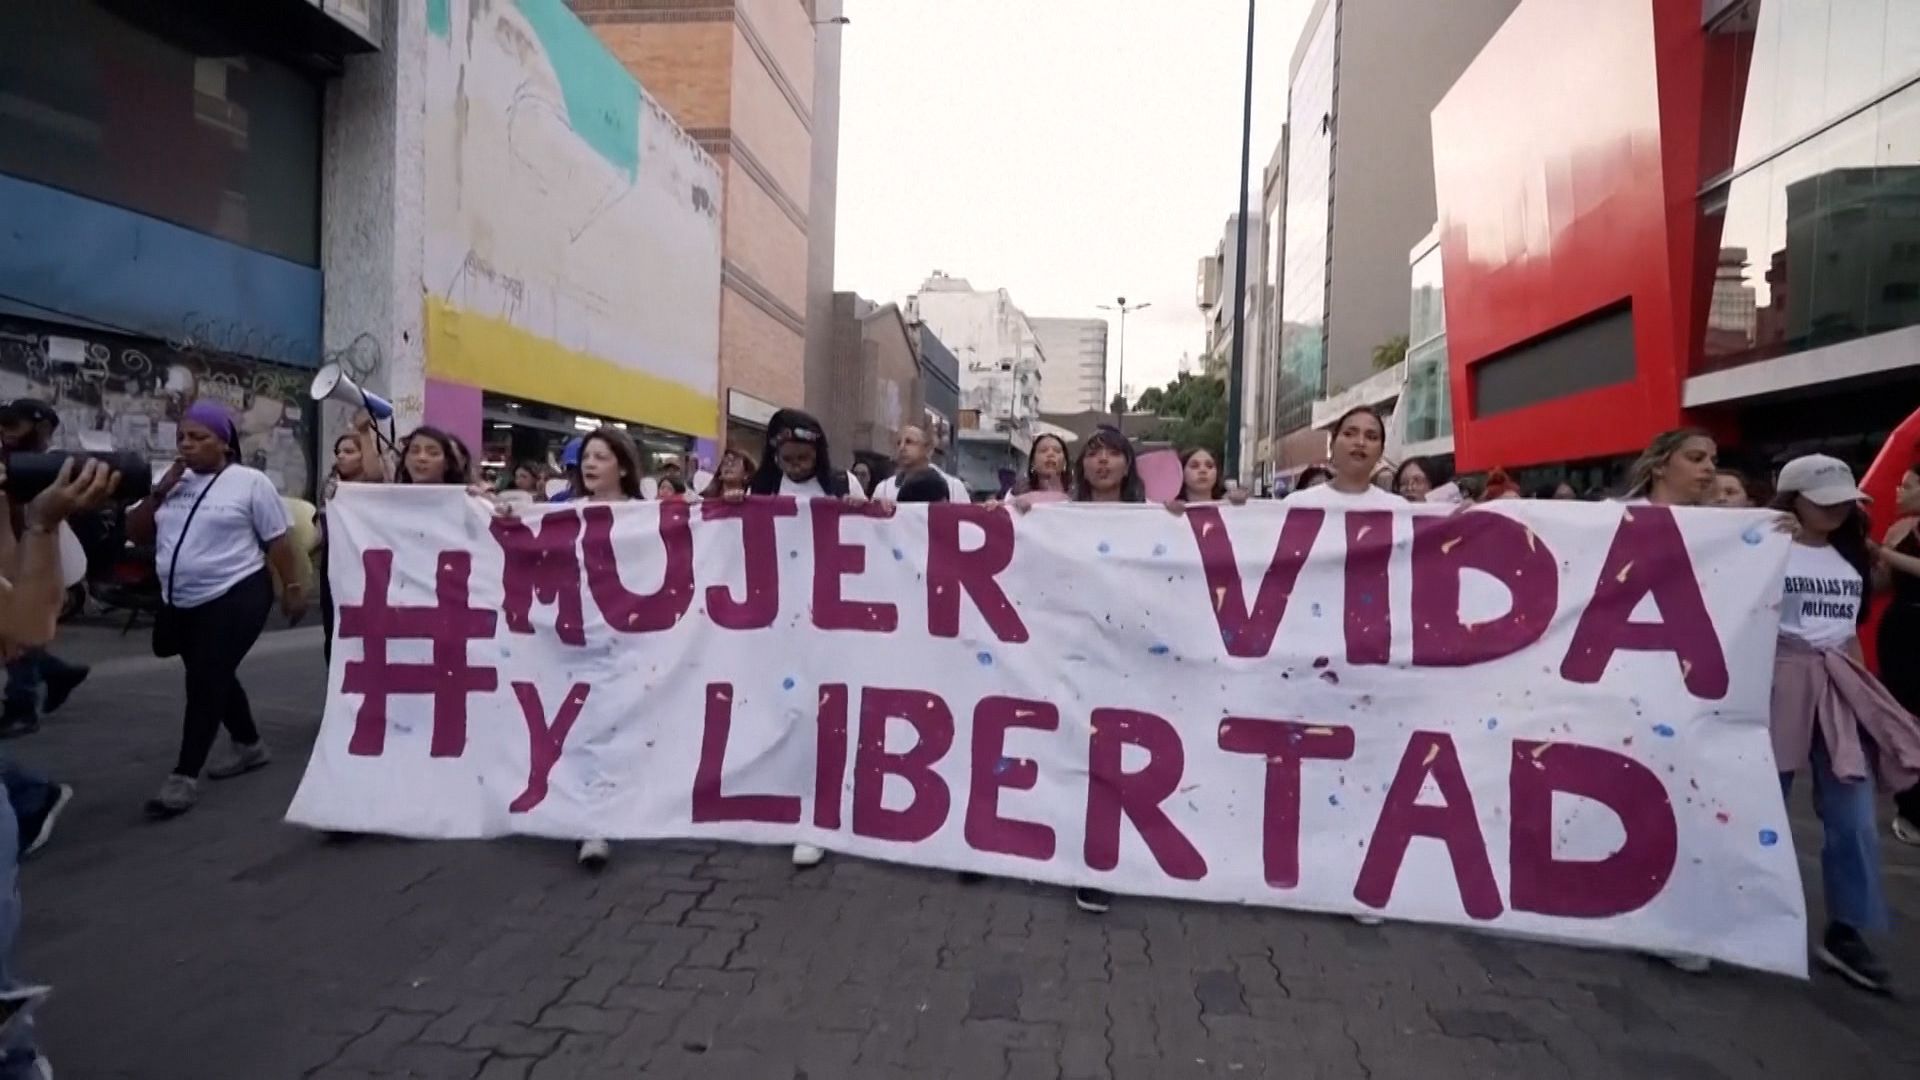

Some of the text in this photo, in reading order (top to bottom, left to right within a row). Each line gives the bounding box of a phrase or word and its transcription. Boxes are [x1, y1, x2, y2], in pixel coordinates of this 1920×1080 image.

[1187, 506, 1729, 700] VIDA
[1783, 576, 1815, 593] BEREN
[692, 682, 1678, 920] LIBERTAD
